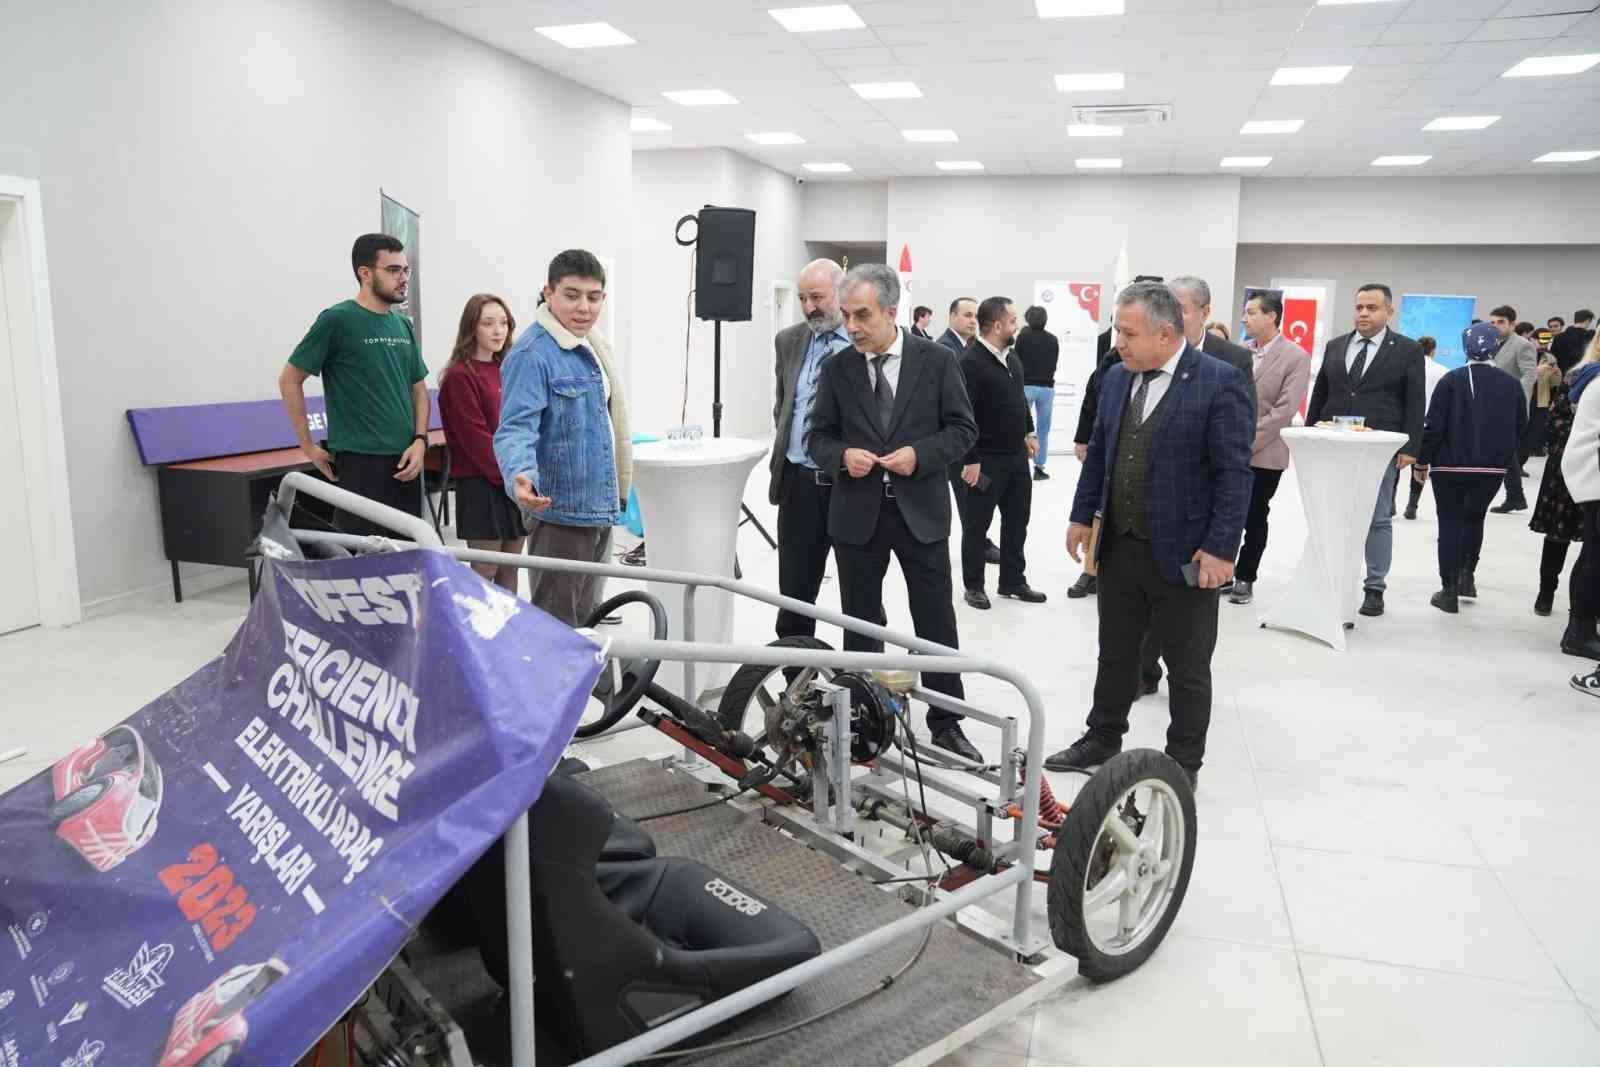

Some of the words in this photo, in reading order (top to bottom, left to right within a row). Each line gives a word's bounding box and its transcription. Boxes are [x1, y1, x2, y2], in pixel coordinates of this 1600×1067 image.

[267, 662, 416, 821] CHALLENGE
[225, 783, 317, 895] YARIŞLARI
[235, 716, 346, 832] ELEKTRİKLİ
[323, 804, 384, 885] ARAÇ
[159, 842, 256, 951] 2023
[704, 877, 768, 916] sparco
